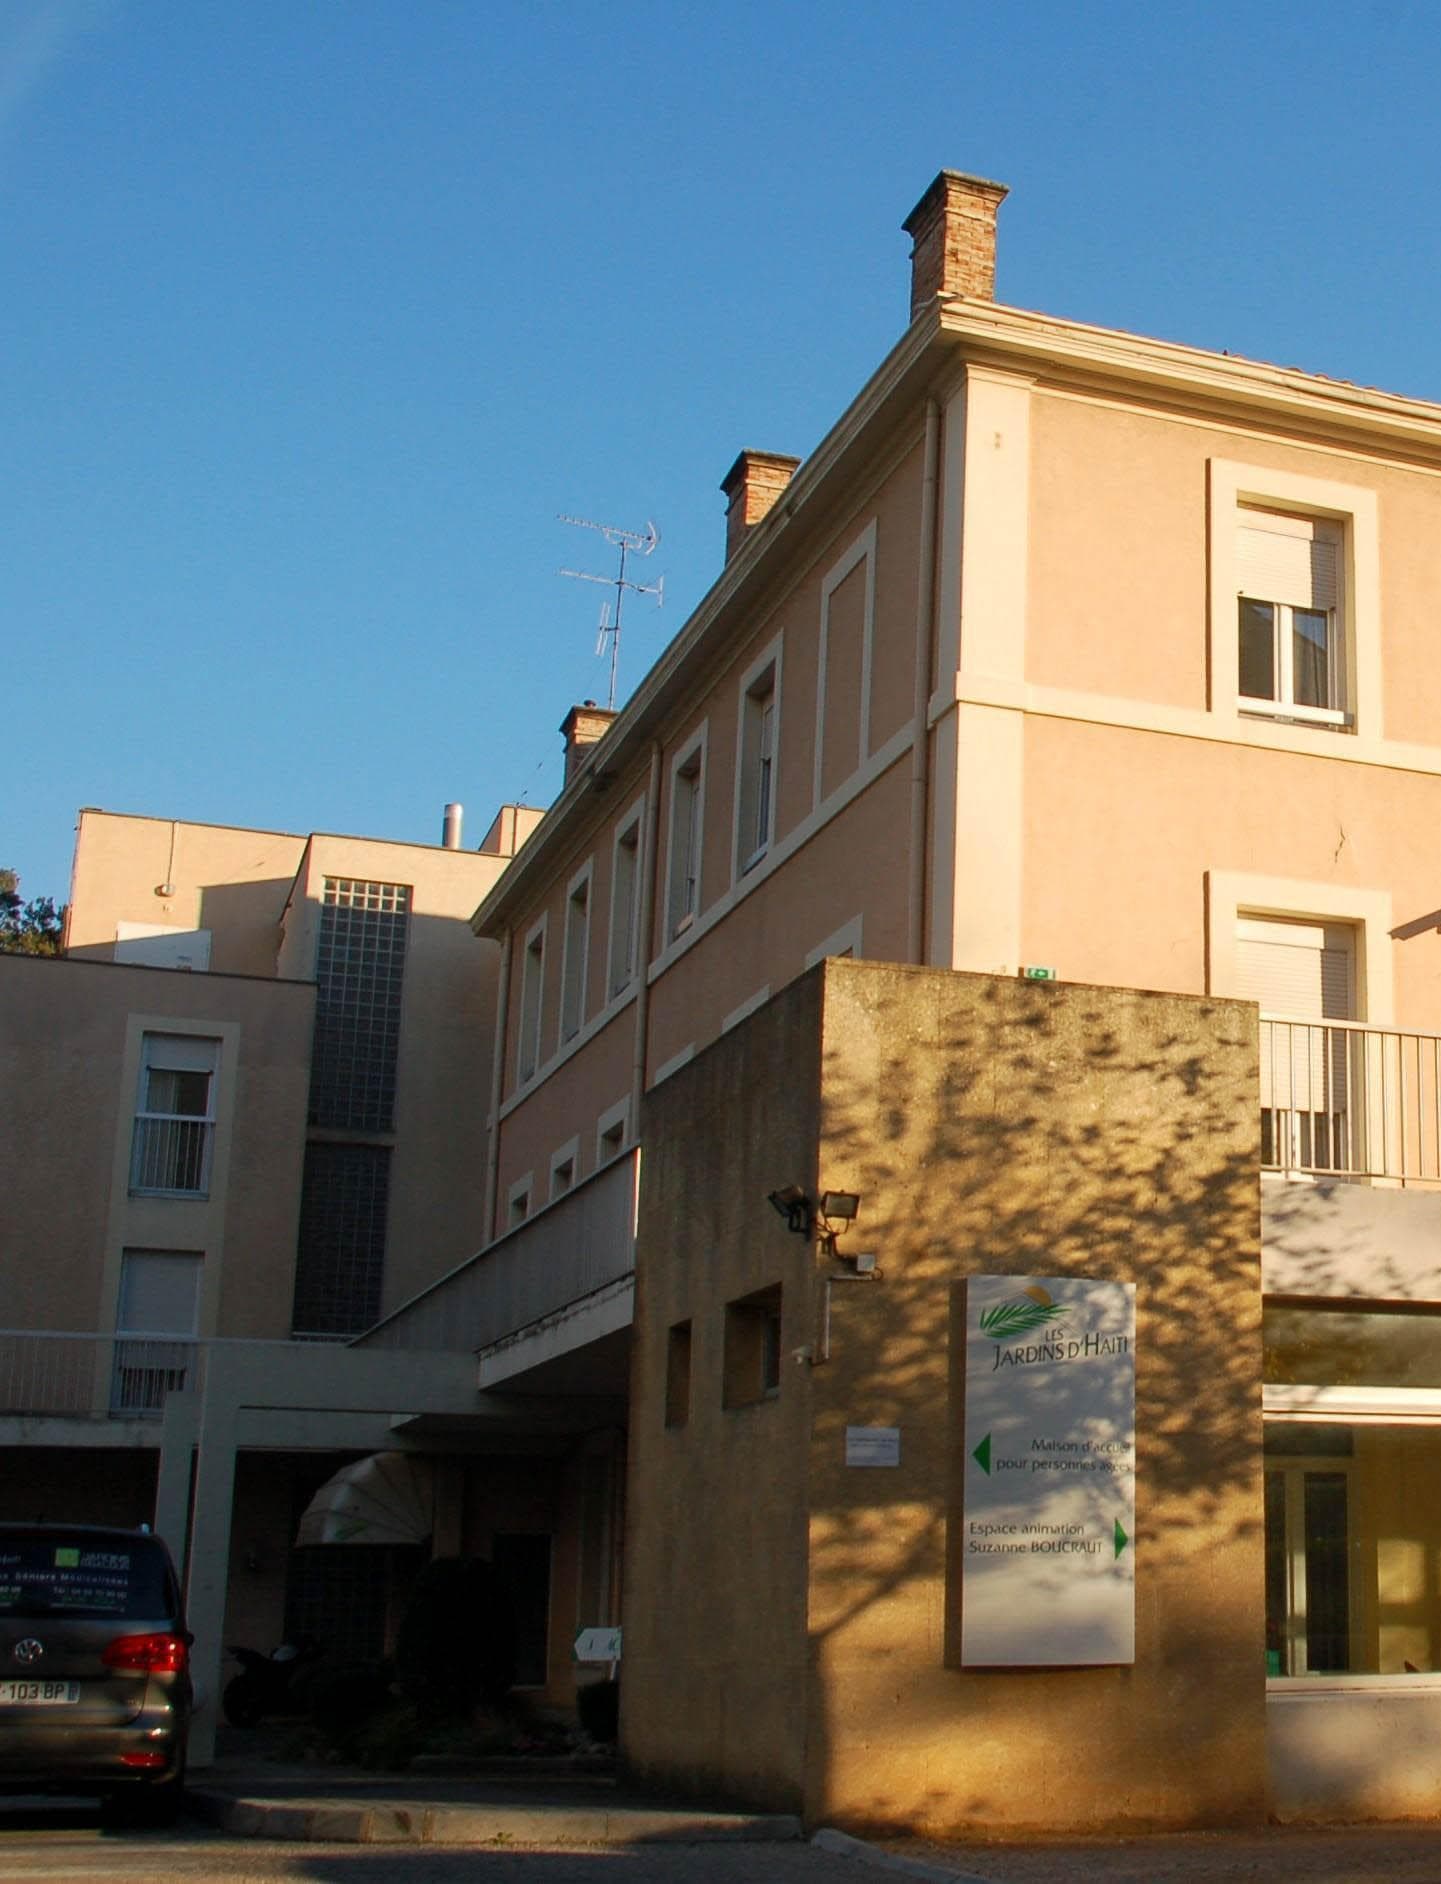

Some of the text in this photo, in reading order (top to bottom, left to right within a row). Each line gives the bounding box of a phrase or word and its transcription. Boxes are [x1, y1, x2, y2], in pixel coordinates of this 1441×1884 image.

[1045, 1329, 1064, 1342] LES
[992, 1343, 1065, 1371] JARDINS
[1031, 1439, 1078, 1452] Maison
[996, 1459, 1028, 1471] pour
[1032, 1460, 1097, 1473] personnes
[970, 1521, 1085, 1537] Espace animation
[968, 1540, 1027, 1554] Suzanne
